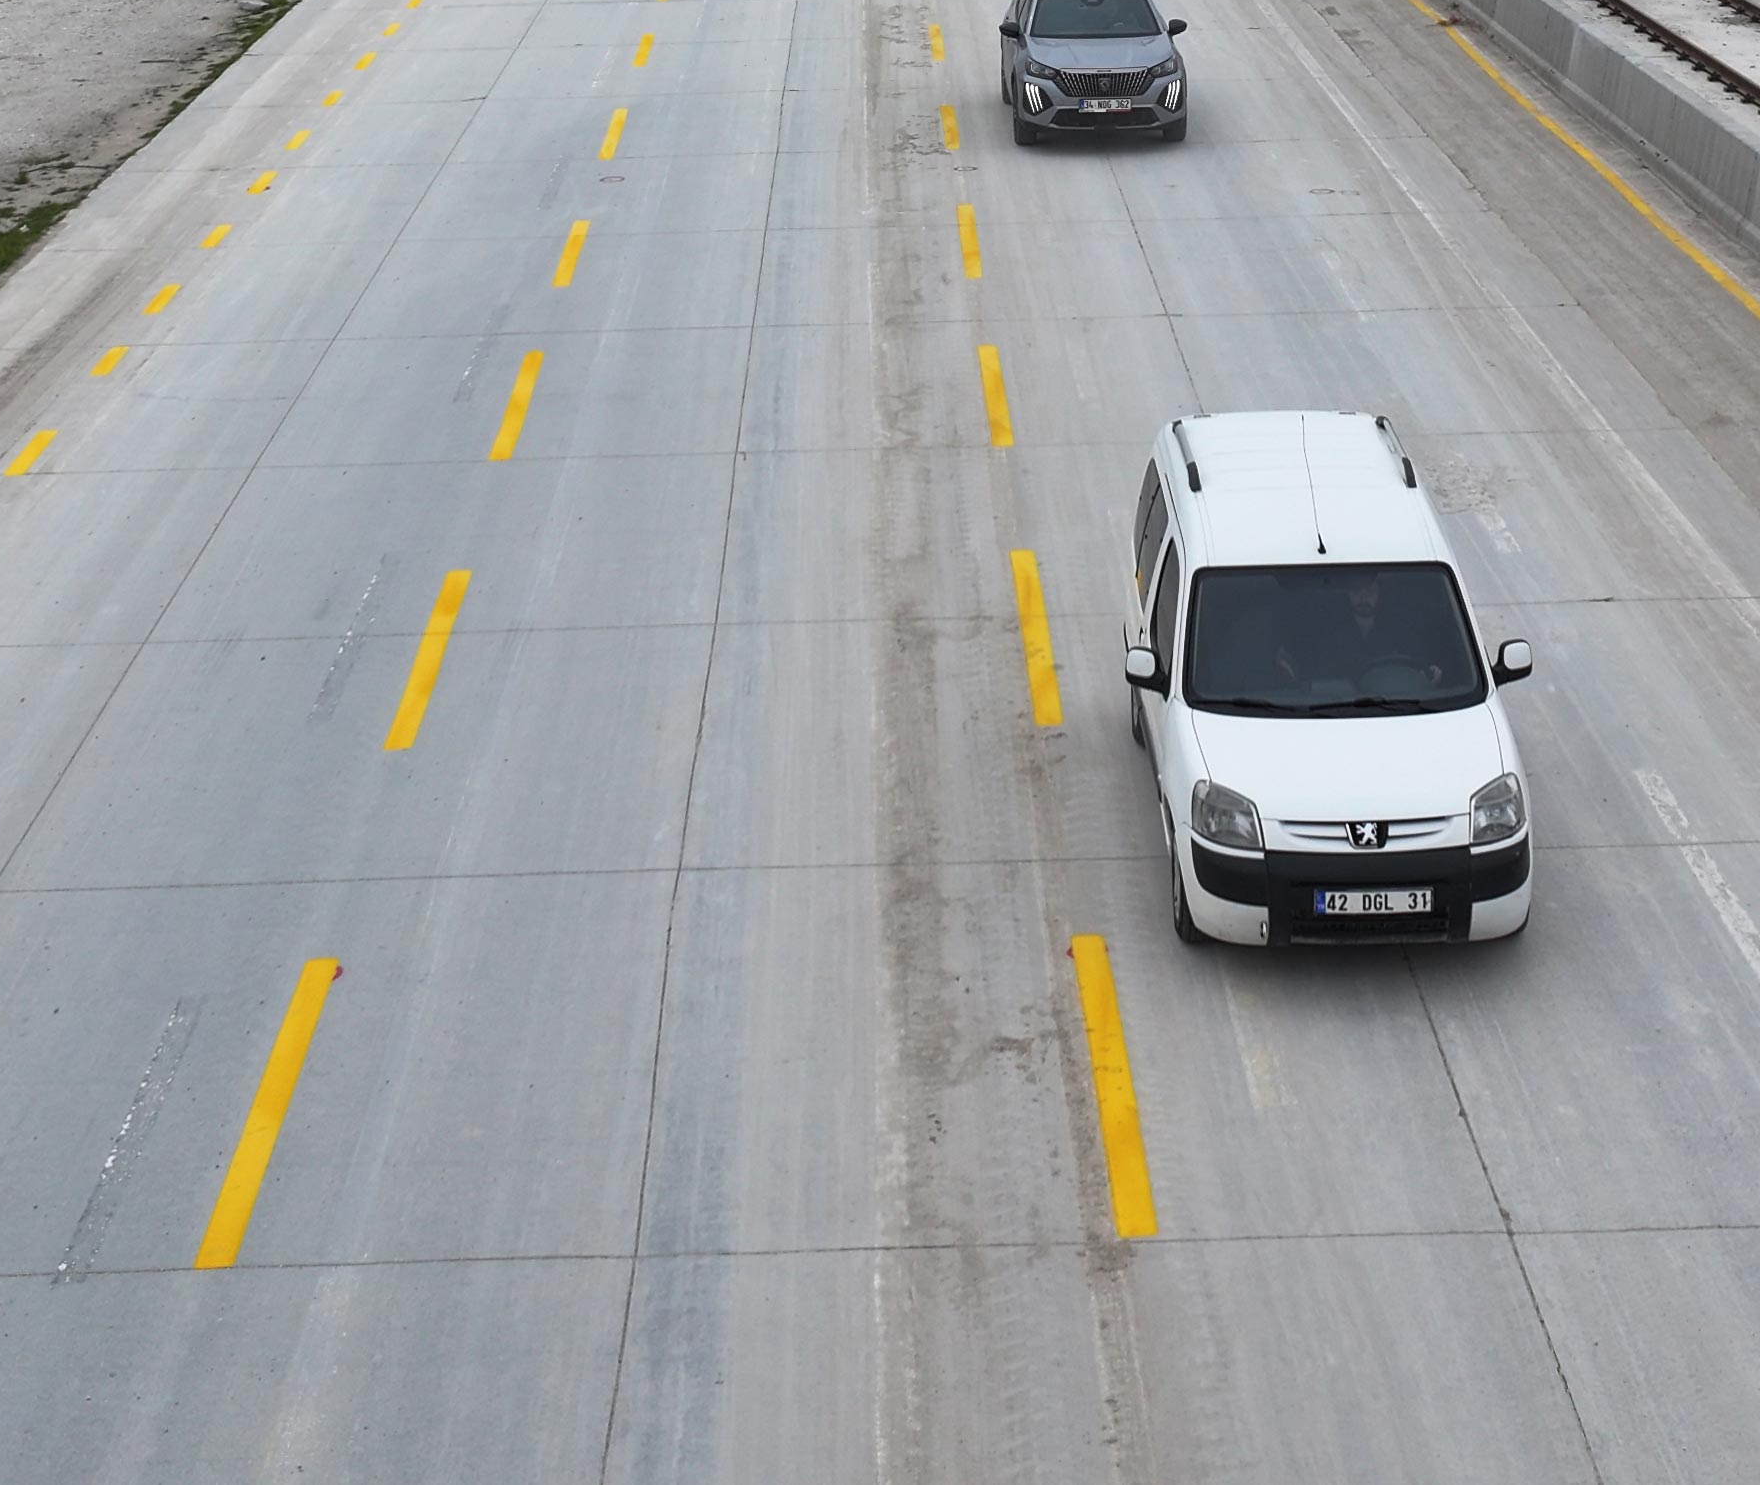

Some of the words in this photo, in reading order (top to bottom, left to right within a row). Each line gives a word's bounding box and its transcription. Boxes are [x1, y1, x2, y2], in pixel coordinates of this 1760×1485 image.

[1084, 100, 1094, 109] 34
[1326, 894, 1348, 912] 42
[1362, 893, 1394, 911] DGL
[1407, 891, 1428, 910] 31
